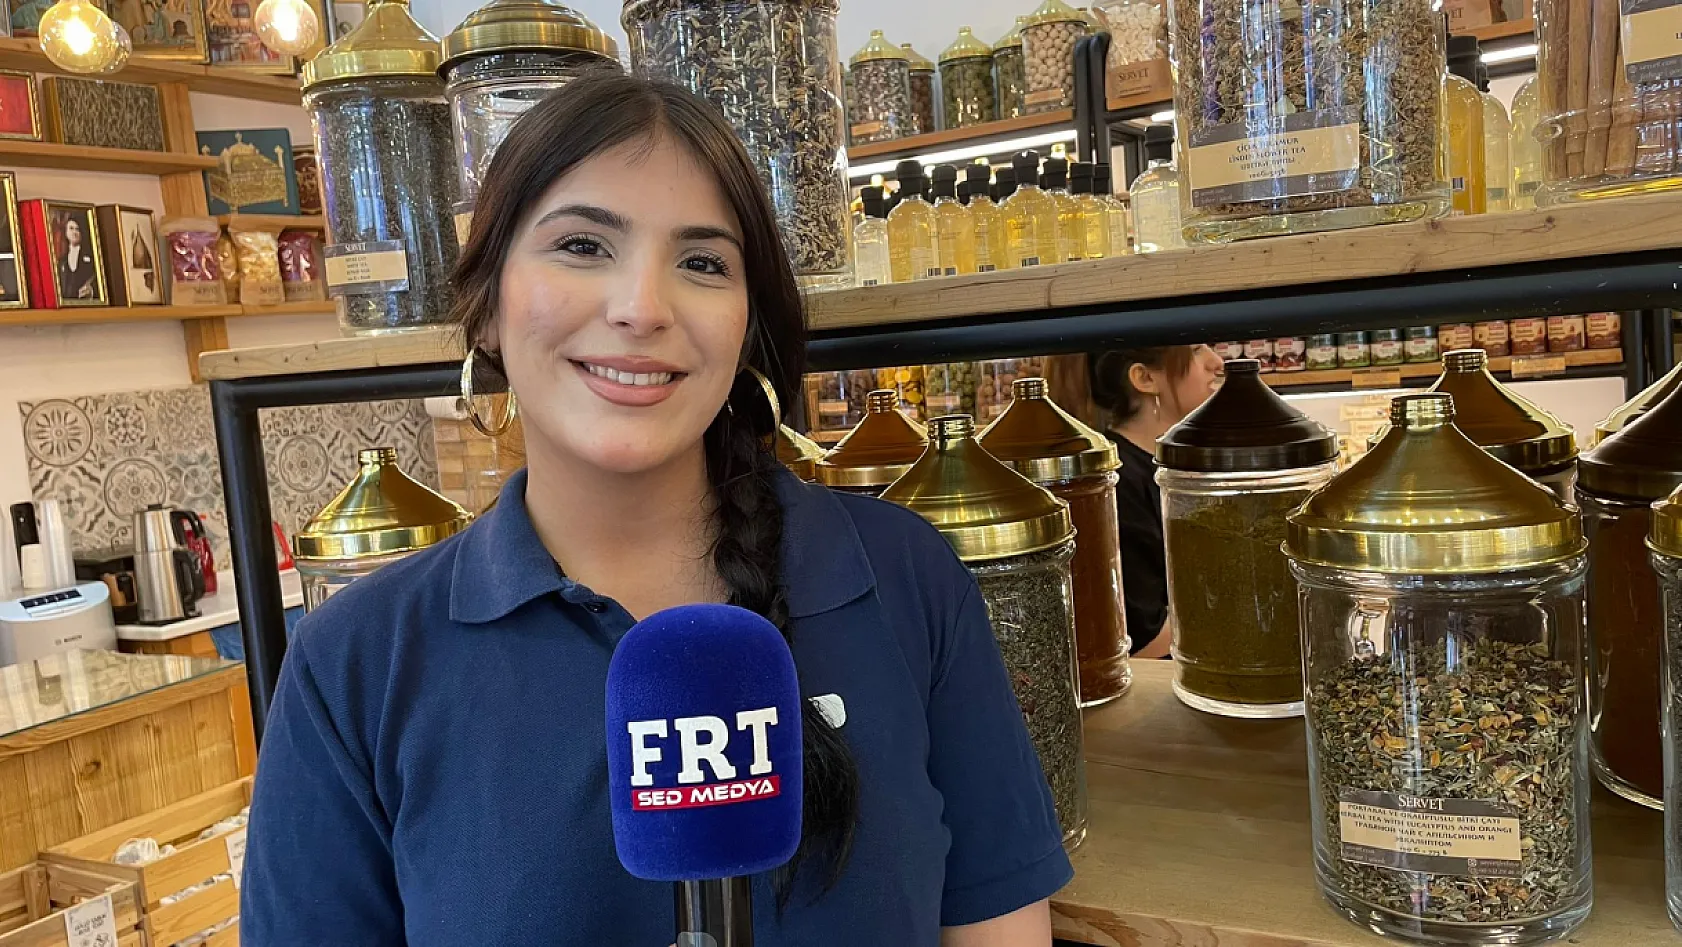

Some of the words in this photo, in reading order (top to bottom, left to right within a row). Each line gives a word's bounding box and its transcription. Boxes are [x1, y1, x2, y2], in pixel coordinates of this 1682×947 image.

[1291, 146, 1305, 154] TEA
[627, 707, 778, 787] FRT
[637, 789, 683, 806] SED
[690, 779, 775, 803] MEDYA
[1399, 794, 1445, 811] SERVET
[1384, 817, 1404, 827] WITH
[1407, 822, 1455, 832] EUCALYPTUS
[1478, 826, 1512, 834] ORANGE
